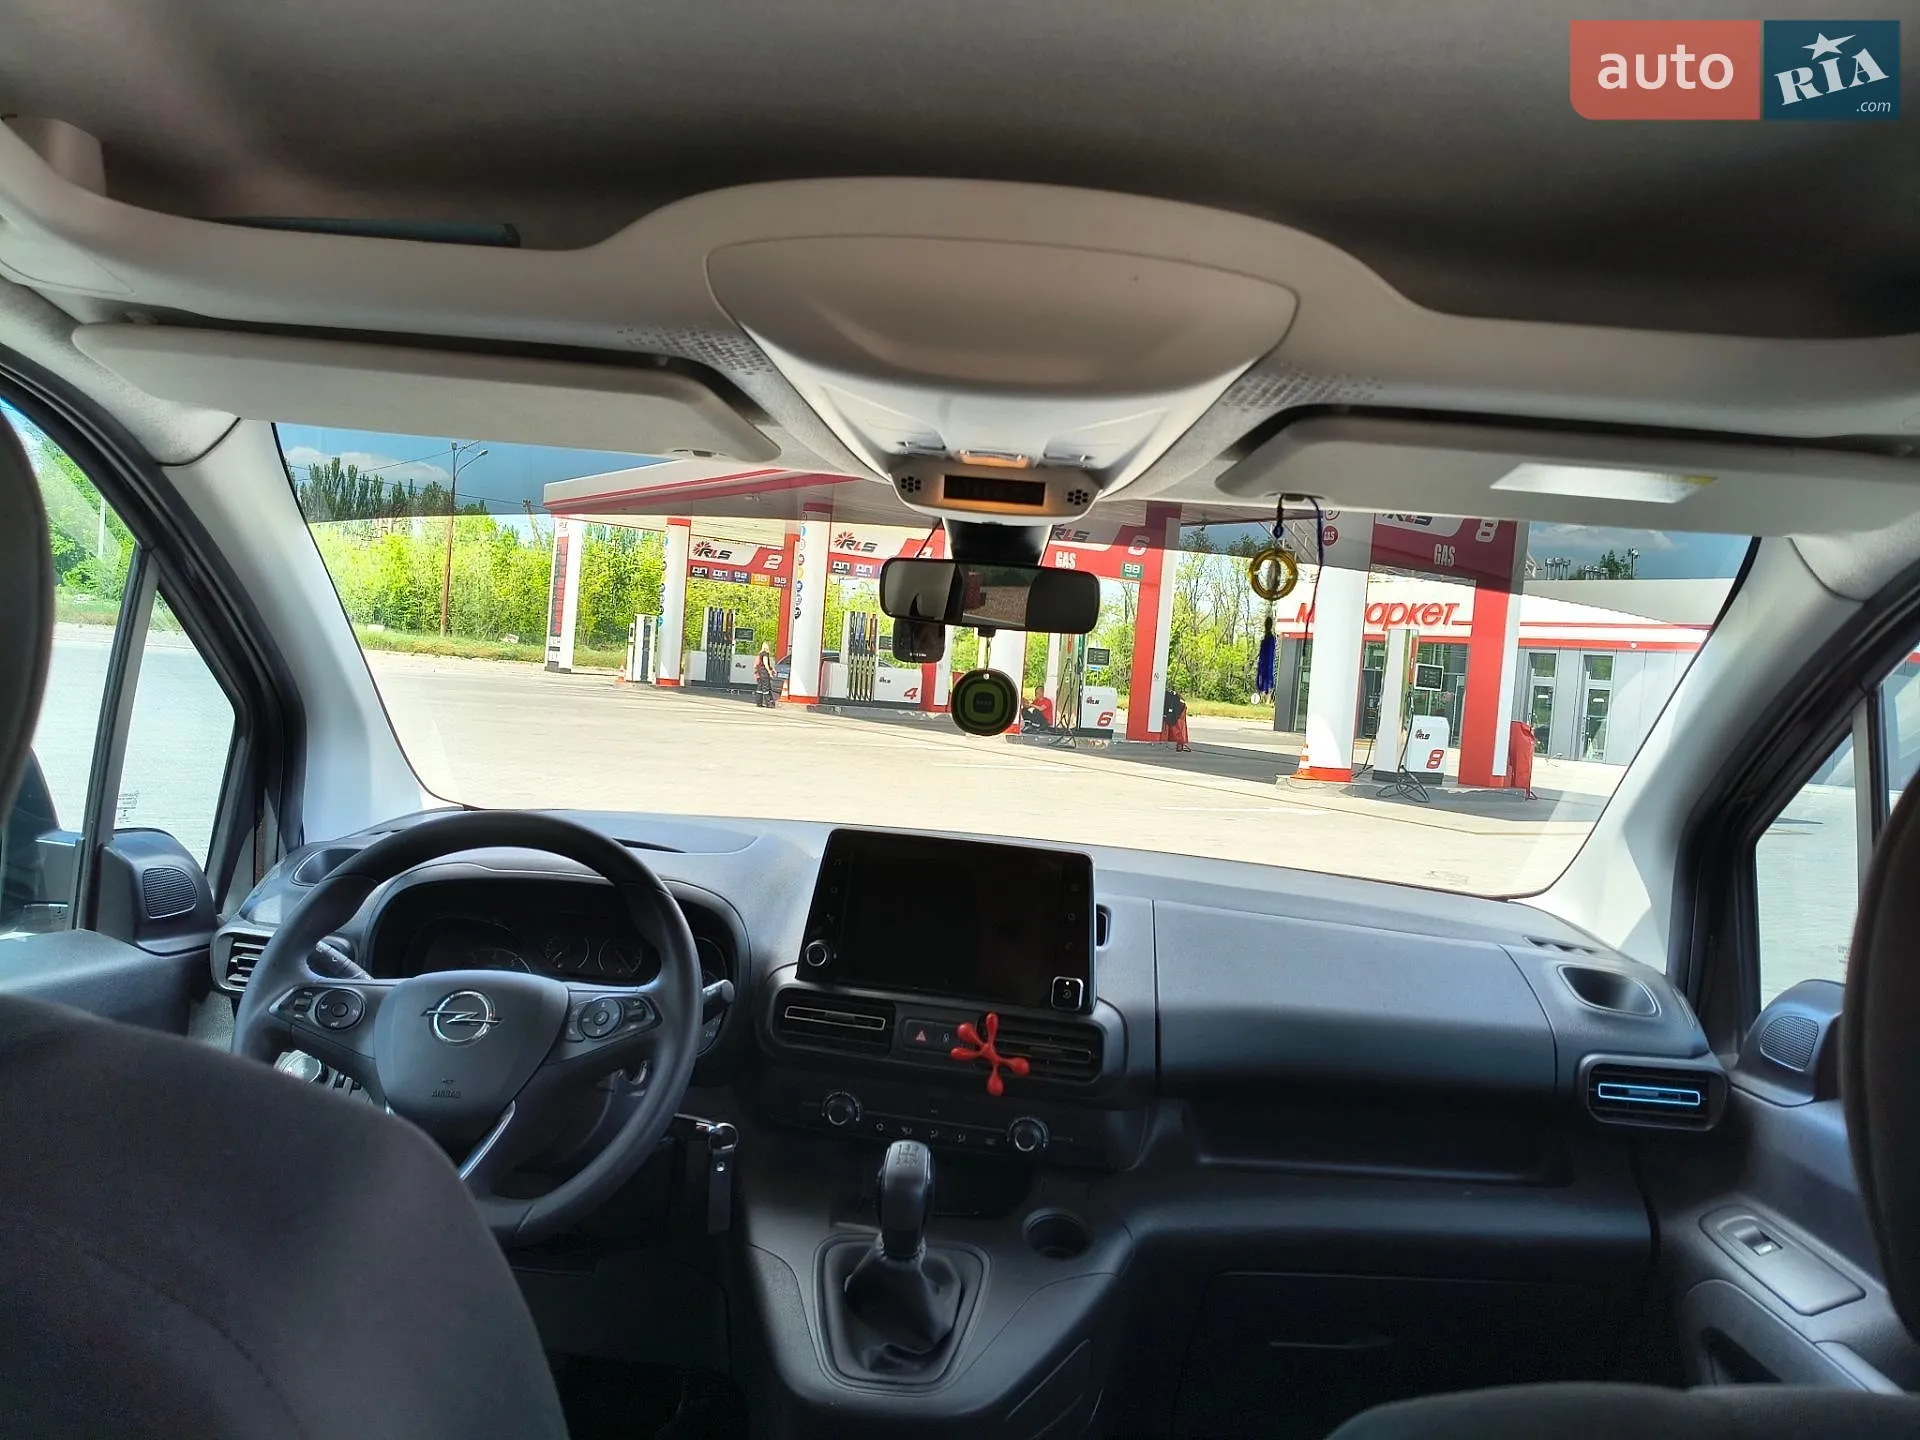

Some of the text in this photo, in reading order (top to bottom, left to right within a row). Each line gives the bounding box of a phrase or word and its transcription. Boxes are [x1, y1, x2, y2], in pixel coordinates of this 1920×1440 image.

[1475, 518, 1499, 543] 8
[698, 547, 733, 560] RLS
[840, 538, 878, 553] RLS
[1128, 534, 1150, 556] 6
[763, 554, 783, 570] 2
[1055, 551, 1076, 569] GAS
[1434, 544, 1456, 567] GAS
[903, 687, 919, 700] 4
[1097, 711, 1114, 727] 6
[1426, 749, 1445, 769] 8
